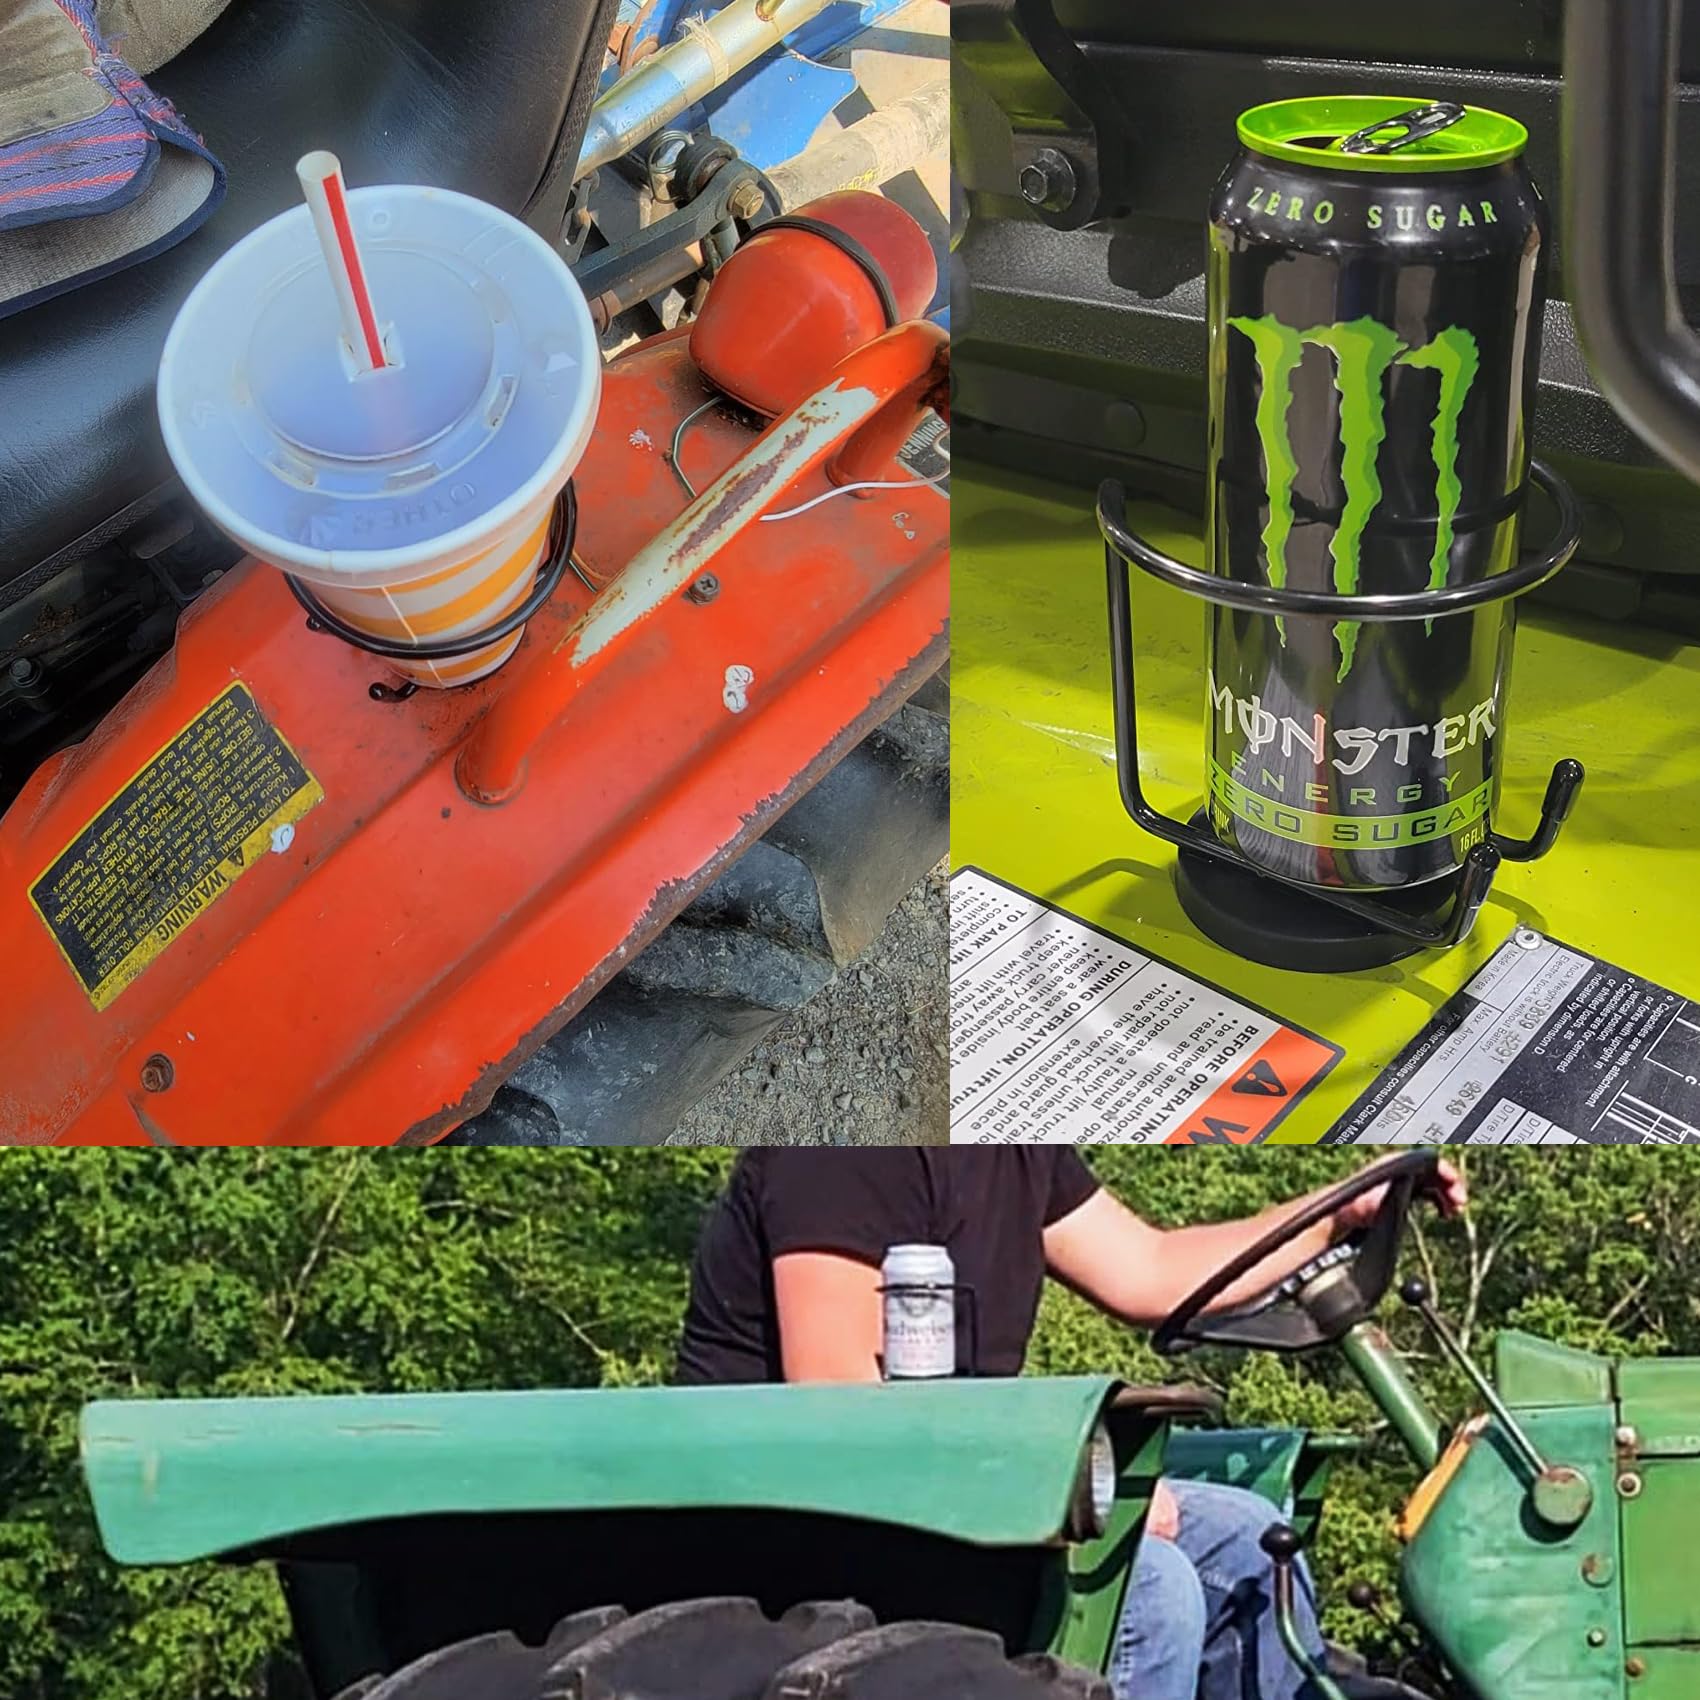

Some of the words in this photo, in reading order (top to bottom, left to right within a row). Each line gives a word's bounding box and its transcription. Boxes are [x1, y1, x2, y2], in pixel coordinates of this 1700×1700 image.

[1246, 186, 1334, 225] ZERO
[1367, 200, 1498, 232] SUGAR
[205, 695, 234, 727] Manual
[1208, 670, 1498, 776] MONSTER
[223, 714, 247, 741] Never
[217, 722, 254, 761] BEFORE
[190, 754, 219, 785] USING
[242, 751, 274, 785] Remove
[1231, 750, 1463, 806] ENERGY
[171, 780, 192, 804] THE
[238, 759, 281, 805] Structures
[258, 770, 288, 802] Kubota
[279, 780, 295, 798] TO
[205, 791, 231, 819] ROPS
[256, 792, 283, 820] AVOID
[1209, 763, 1301, 835] ZERO
[1333, 788, 1488, 843] SUGAR
[135, 799, 173, 840] TRACTOR
[212, 798, 257, 844] recommends
[125, 835, 137, 849] IN
[215, 813, 259, 859] PERSONAL
[100, 845, 128, 875] OTHER
[187, 853, 218, 885] INJURY
[175, 879, 191, 897] OR
[151, 891, 179, 921] DEATH
[153, 866, 228, 943] WARNING
[950, 895, 980, 914] turn
[960, 900, 994, 921] shift
[1003, 908, 1028, 923] TO
[132, 915, 155, 941] FROM
[967, 922, 1009, 949] PARK
[1016, 932, 1058, 960] travel
[1032, 937, 1070, 963] keep
[1043, 946, 1082, 973] never
[1496, 948, 1518, 966] Made
[990, 958, 1023, 980] with
[1002, 961, 1041, 987] truck
[1058, 950, 1096, 976] keep
[1073, 958, 1108, 983] wear
[1543, 954, 1570, 980] Electric
[1562, 960, 1585, 980] Truck
[950, 978, 975, 999] and
[972, 978, 997, 994] lift
[1008, 971, 1048, 998] carry
[1025, 974, 1067, 1004] entire
[1064, 981, 1079, 990] a
[1076, 959, 1133, 1002] DURING
[1473, 971, 1498, 991] Korea
[1540, 977, 1569, 1003] Weight
[1574, 972, 1606, 1004] indicated
[1605, 977, 1617, 987] or
[967, 984, 1008, 1013] away
[1037, 988, 1071, 1012] seat
[1130, 987, 1165, 1012] have
[1153, 994, 1179, 1012] not
[1166, 1000, 1192, 1019] not
[1563, 1000, 1582, 1013] by
[1586, 986, 1612, 1010] shifted
[1595, 980, 1633, 1018] Capacities
[1616, 988, 1643, 1015] vertical
[1642, 994, 1654, 1005] or
[992, 1001, 1033, 1029] body
[1013, 1010, 1045, 1032] belt
[1110, 1011, 1137, 1030] the
[1116, 1009, 1160, 1042] repair
[1500, 1002, 1529, 1027] without
[1569, 1007, 1595, 1030] loads,
[1588, 1016, 1605, 1030] are
[1628, 1003, 1650, 1023] forks
[1633, 1000, 1670, 1039] Capacities
[994, 1000, 1084, 1068] OPERATION,
[1120, 1016, 1173, 1058] operate
[1187, 1016, 1220, 1042] read
[1212, 1023, 1235, 1039] be
[1424, 1024, 1452, 1044] other
[1448, 1026, 1476, 1046] Amp
[1475, 1026, 1509, 1053] Battery
[1537, 1011, 1575, 1047] dimension
[1561, 1029, 1576, 1040] as
[1579, 1029, 1597, 1041] for
[1592, 1012, 1625, 1043] position.
[1617, 1020, 1638, 1037] with
[956, 1026, 1002, 1059] inside
[1053, 1028, 1118, 1078] overhead
[1102, 1040, 1126, 1057] lift
[1165, 1040, 1194, 1062] and
[1202, 1024, 1260, 1073] BEFORE
[1553, 1039, 1589, 1073] centered
[1595, 1034, 1626, 1062] upright
[1626, 1037, 1643, 1051] are
[1017, 1037, 1085, 1089] extension
[1113, 1056, 1128, 1066] a
[1172, 1037, 1220, 1076] trained
[1390, 1042, 1435, 1077] capacities
[1591, 1060, 1608, 1070] in
[1613, 1049, 1635, 1067] with
[971, 1066, 1003, 1088] lift
[1068, 1055, 1109, 1086] truck
[1077, 1063, 1122, 1097] faulty
[1004, 1087, 1026, 1101] in
[1013, 1074, 1062, 1111] guard
[1088, 1067, 1141, 1110] manual
[1098, 1061, 1172, 1123] understand
[1149, 1073, 1181, 1098] and
[1367, 1077, 1405, 1104] consult
[1582, 1065, 1624, 1107] attachment
[964, 1097, 1012, 1132] place
[1028, 1083, 1076, 1121] unless
[1061, 1094, 1088, 1114] lift
[1127, 1071, 1211, 1144] OPERATING
[1349, 1104, 1380, 1124] Clark
[990, 1108, 1024, 1133] and
[1025, 1111, 1069, 1144] truck
[1483, 1104, 1518, 1132] D/Tire
